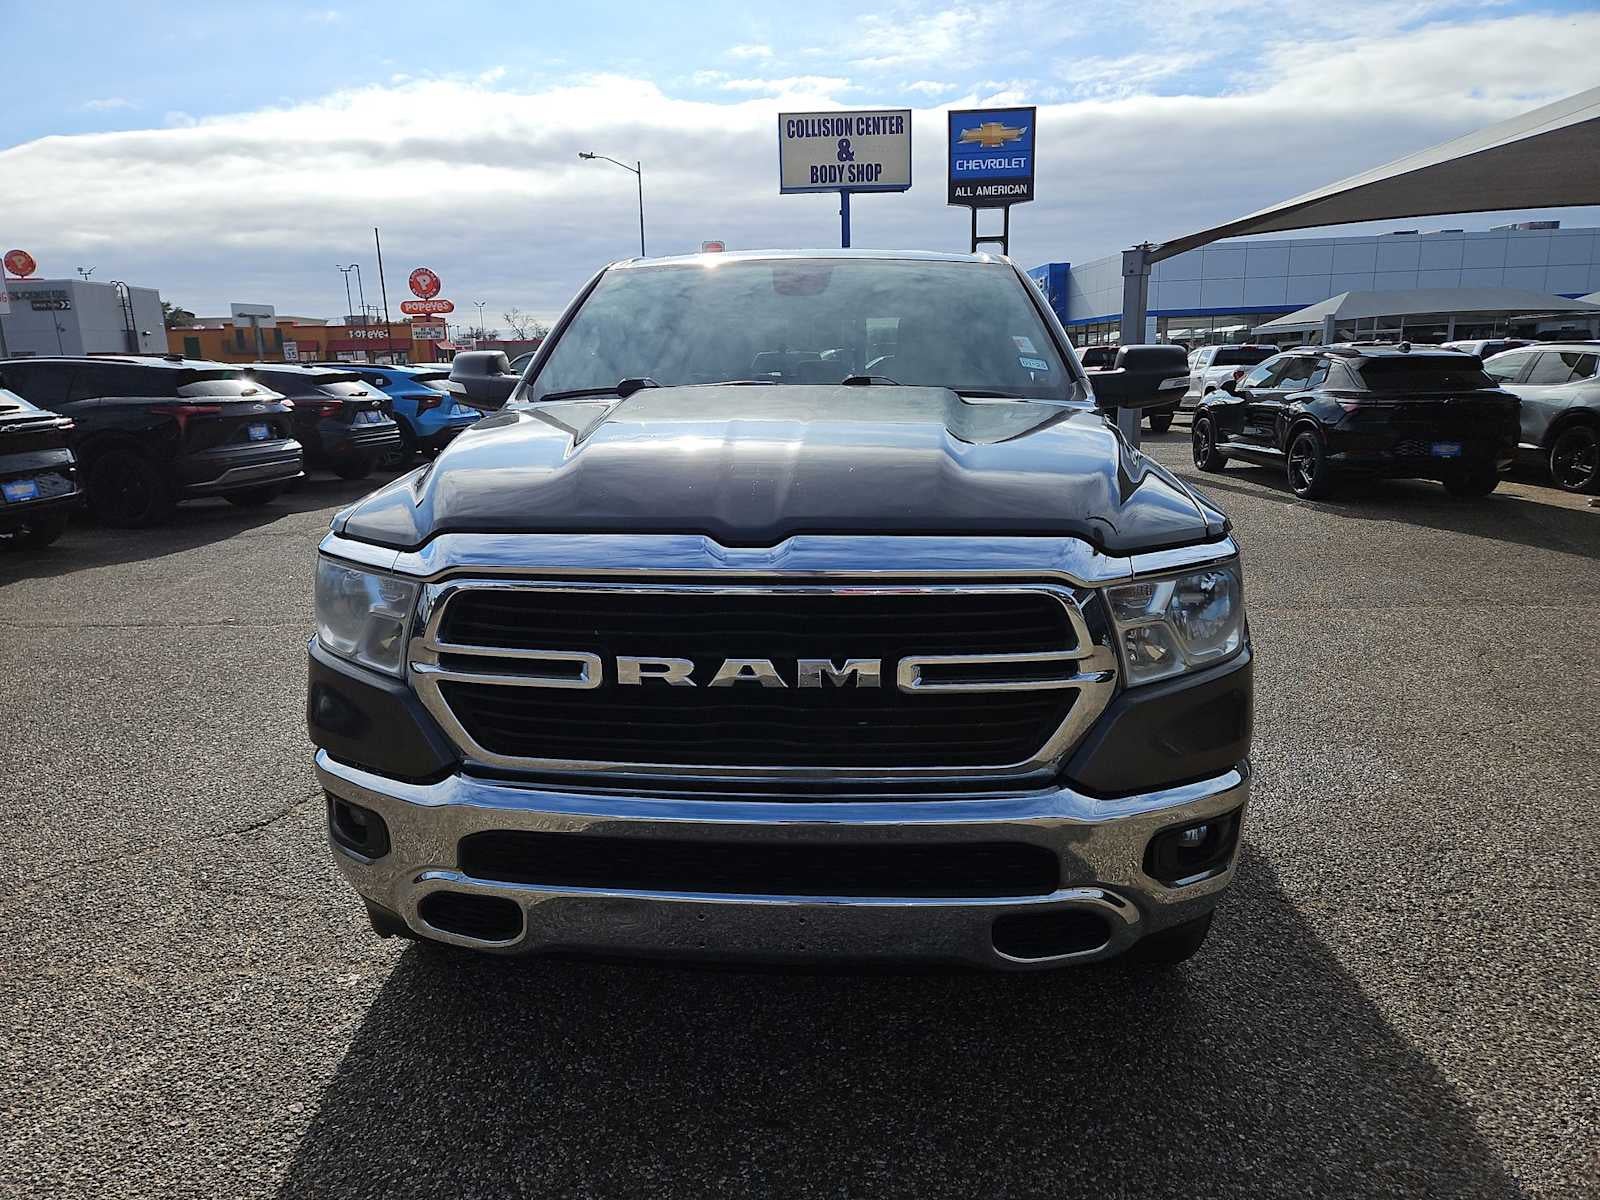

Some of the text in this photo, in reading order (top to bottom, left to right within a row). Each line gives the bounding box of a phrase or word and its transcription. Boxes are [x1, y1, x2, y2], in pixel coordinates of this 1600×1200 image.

[787, 116, 904, 138] COLLISION CENTER
[837, 138, 855, 161] &
[810, 163, 882, 184] BODY SHOP
[956, 157, 1026, 171] CHEVROLET
[955, 184, 1028, 197] ALL AMERICAN
[616, 655, 881, 688] RAM
